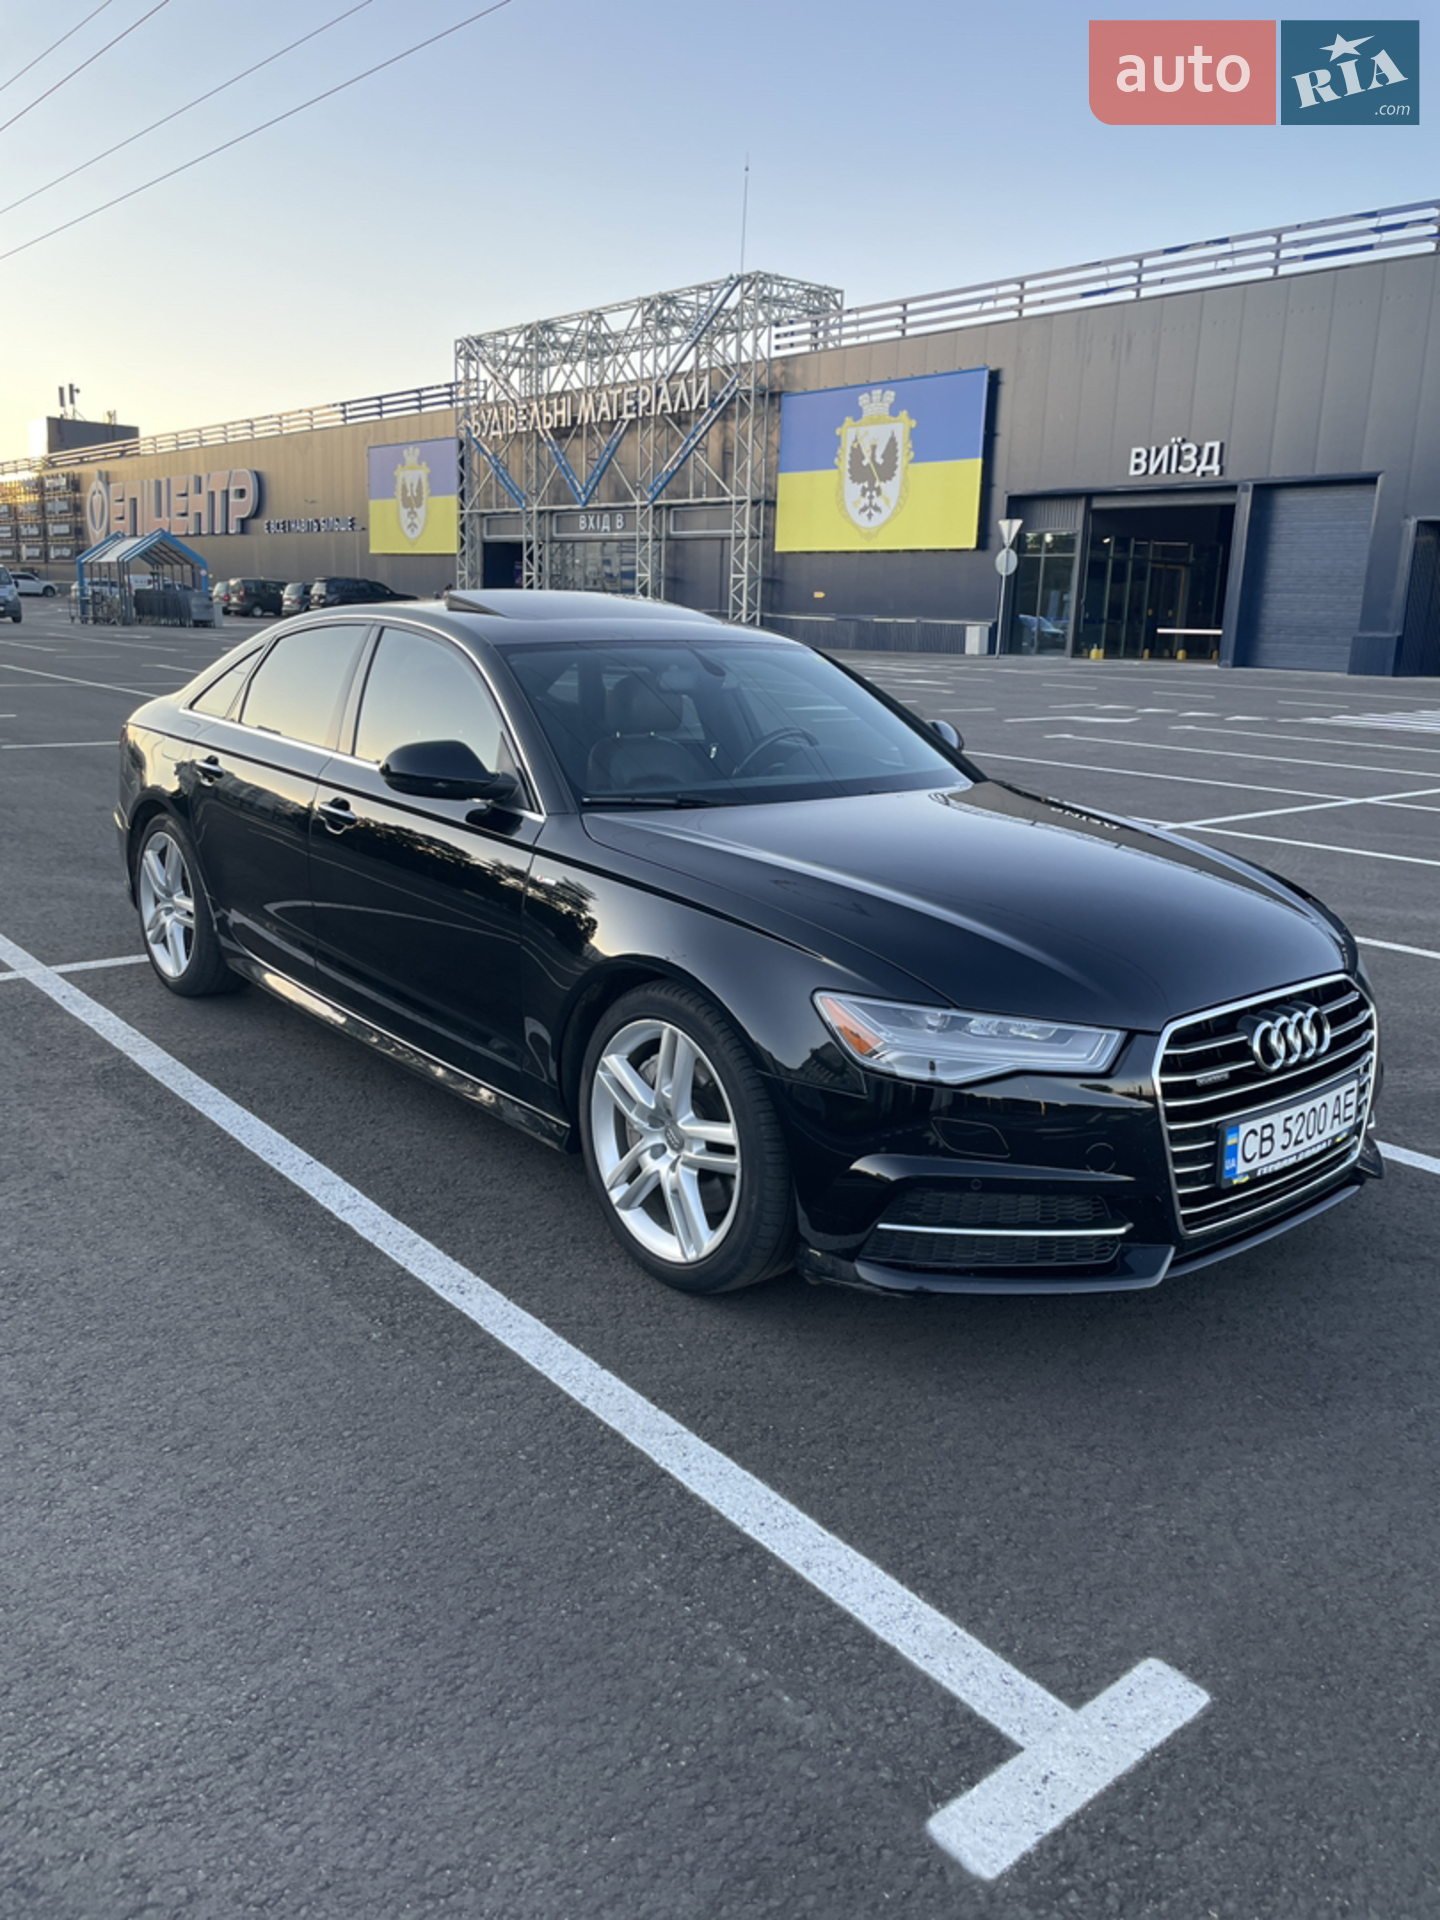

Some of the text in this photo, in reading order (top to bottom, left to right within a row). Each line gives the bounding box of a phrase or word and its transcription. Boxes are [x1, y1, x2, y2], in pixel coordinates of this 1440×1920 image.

[471, 375, 709, 440] БУДІВЕЛЬНІ МАТЕРІАЛИ
[1129, 436, 1221, 477] ВИЇЗД
[110, 469, 257, 535] ЕПІЦЕНТР
[579, 514, 610, 532] ВХІД
[1241, 1123, 1275, 1164] CB
[1281, 1102, 1327, 1151] 5200
[1330, 1087, 1356, 1130] AE
